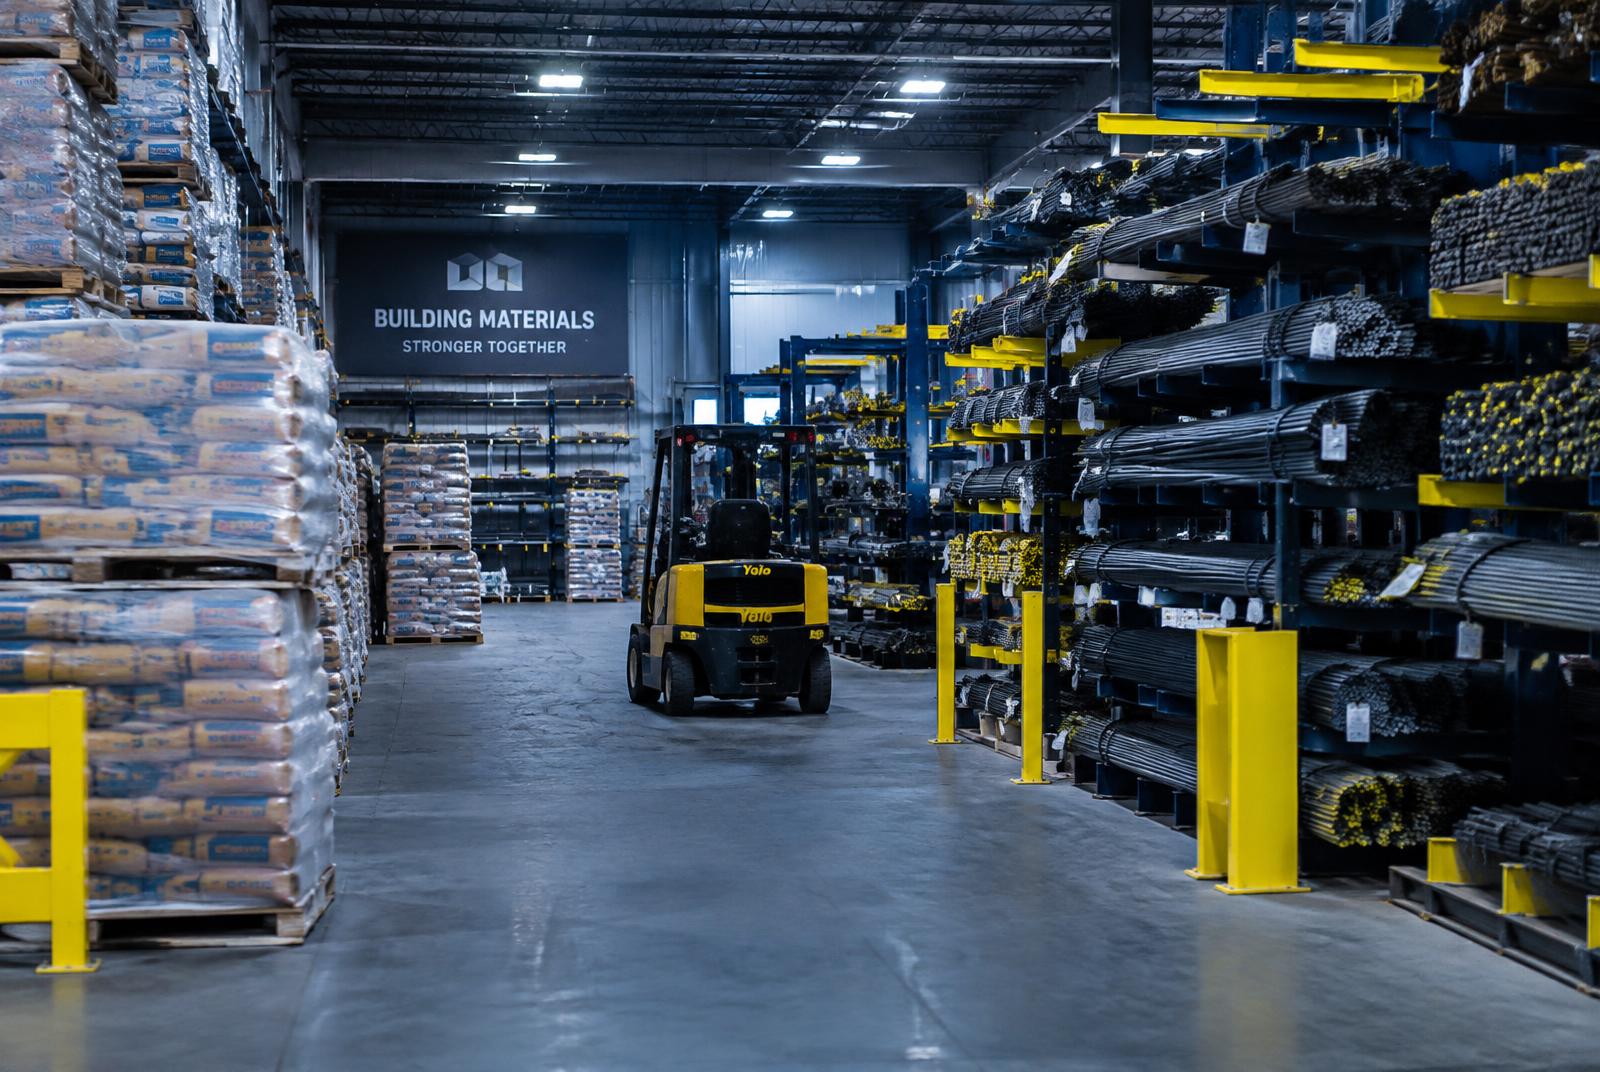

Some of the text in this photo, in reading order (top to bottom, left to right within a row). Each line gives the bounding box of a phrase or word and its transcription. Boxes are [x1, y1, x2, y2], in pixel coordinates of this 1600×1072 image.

[374, 308, 595, 330] BUILDING MATERIALS
[402, 339, 567, 355] STRONGER TOGETHER
